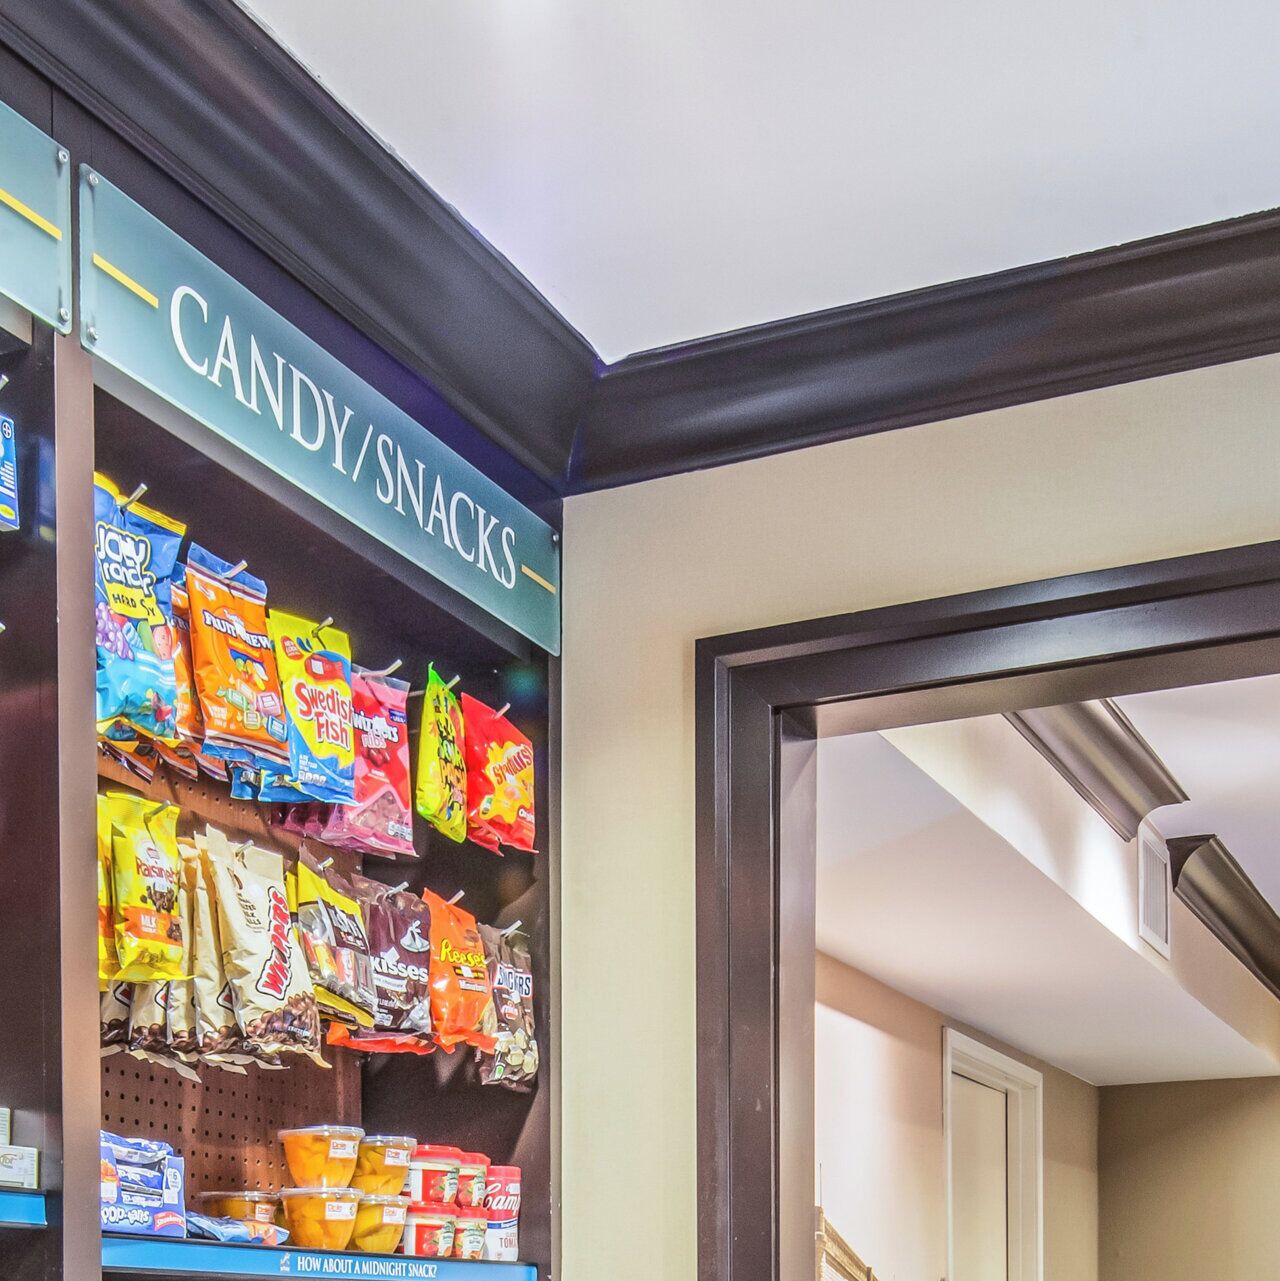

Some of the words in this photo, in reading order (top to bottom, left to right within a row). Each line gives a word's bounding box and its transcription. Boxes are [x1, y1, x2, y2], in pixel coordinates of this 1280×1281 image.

[171, 284, 517, 590] CANDY/SNACKS
[316, 711, 352, 752] Fish
[372, 953, 429, 985] Kisses
[439, 938, 487, 969] Reese's
[298, 1256, 322, 1272] HOW
[323, 1257, 353, 1273] ABOUT
[354, 1260, 361, 1273] A
[362, 1260, 407, 1276] MIDNIGHT
[408, 1262, 438, 1278] SNACK?
